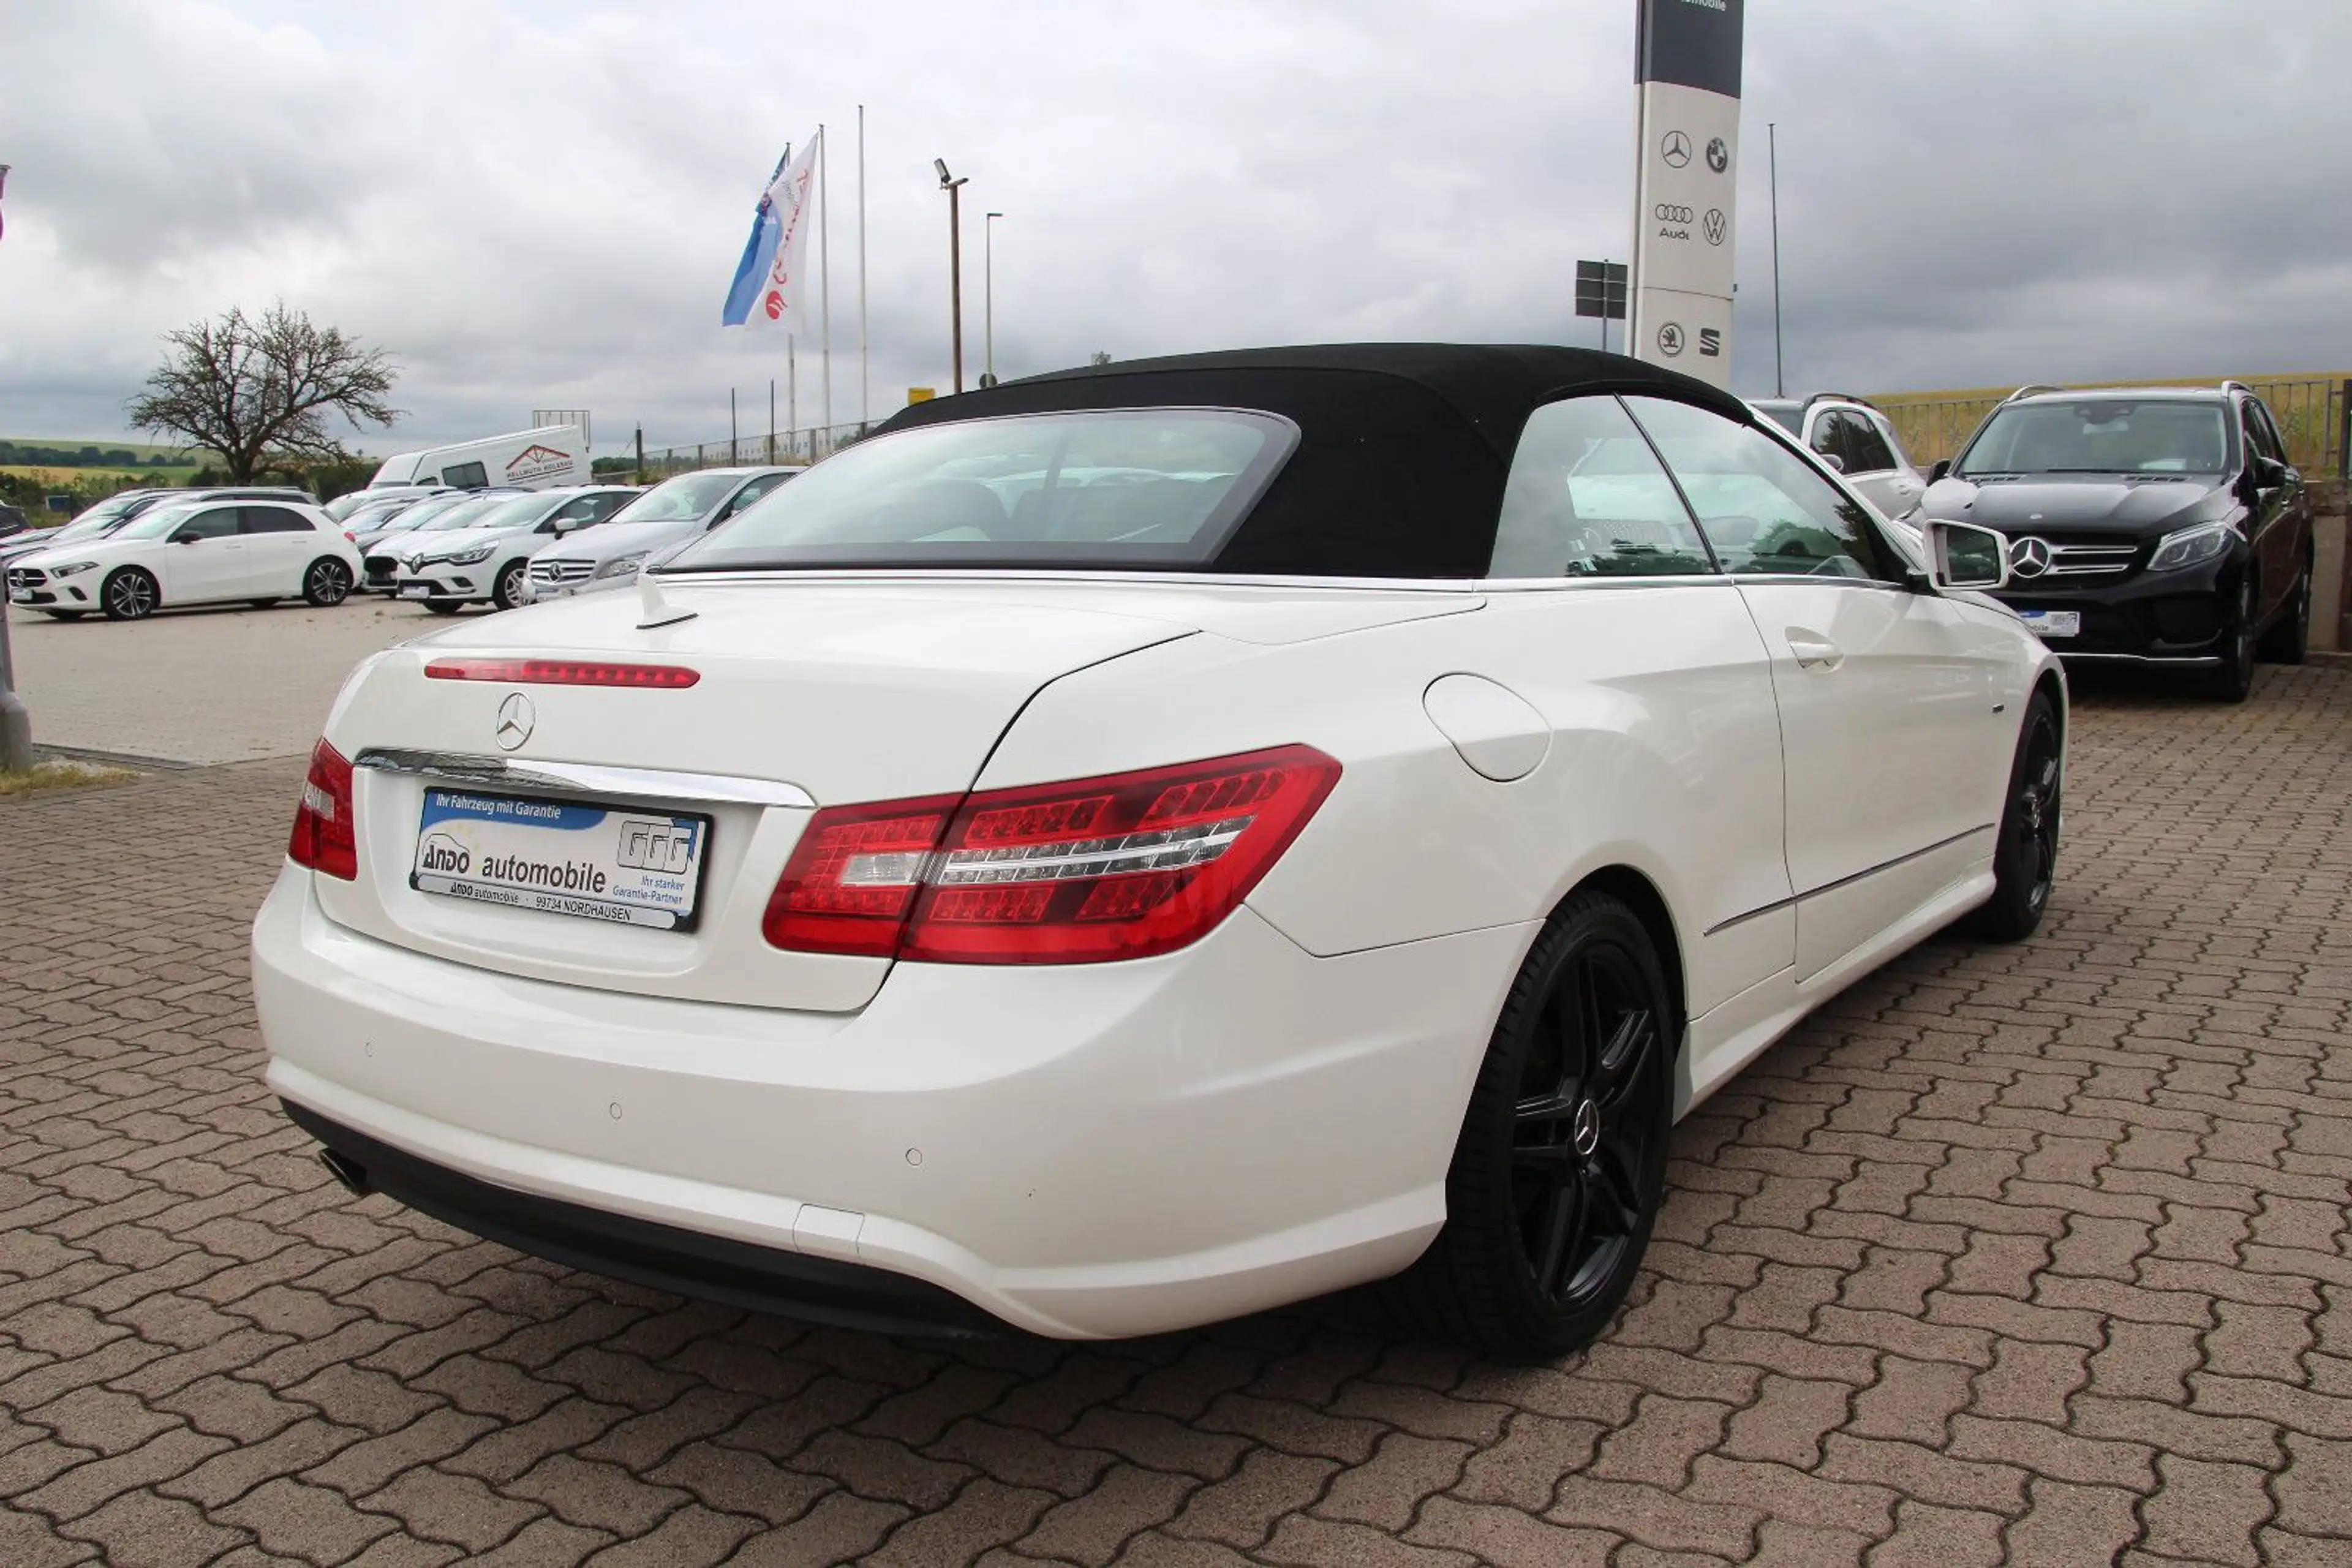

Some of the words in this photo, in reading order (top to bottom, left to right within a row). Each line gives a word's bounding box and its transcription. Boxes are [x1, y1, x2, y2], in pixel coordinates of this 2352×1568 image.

[1659, 227, 1689, 240] Audi
[436, 794, 448, 807] Ihr
[451, 795, 494, 815] Fahrzeug
[496, 801, 513, 813] mit
[516, 802, 561, 819] Garantie
[482, 855, 606, 893] automobile
[641, 875, 653, 886] Ihr
[654, 878, 685, 891] starker
[475, 888, 518, 903] automobile
[536, 896, 561, 910] 99734
[564, 900, 631, 921] NORDHAUSEN
[612, 885, 683, 905] Garantie-Partner
